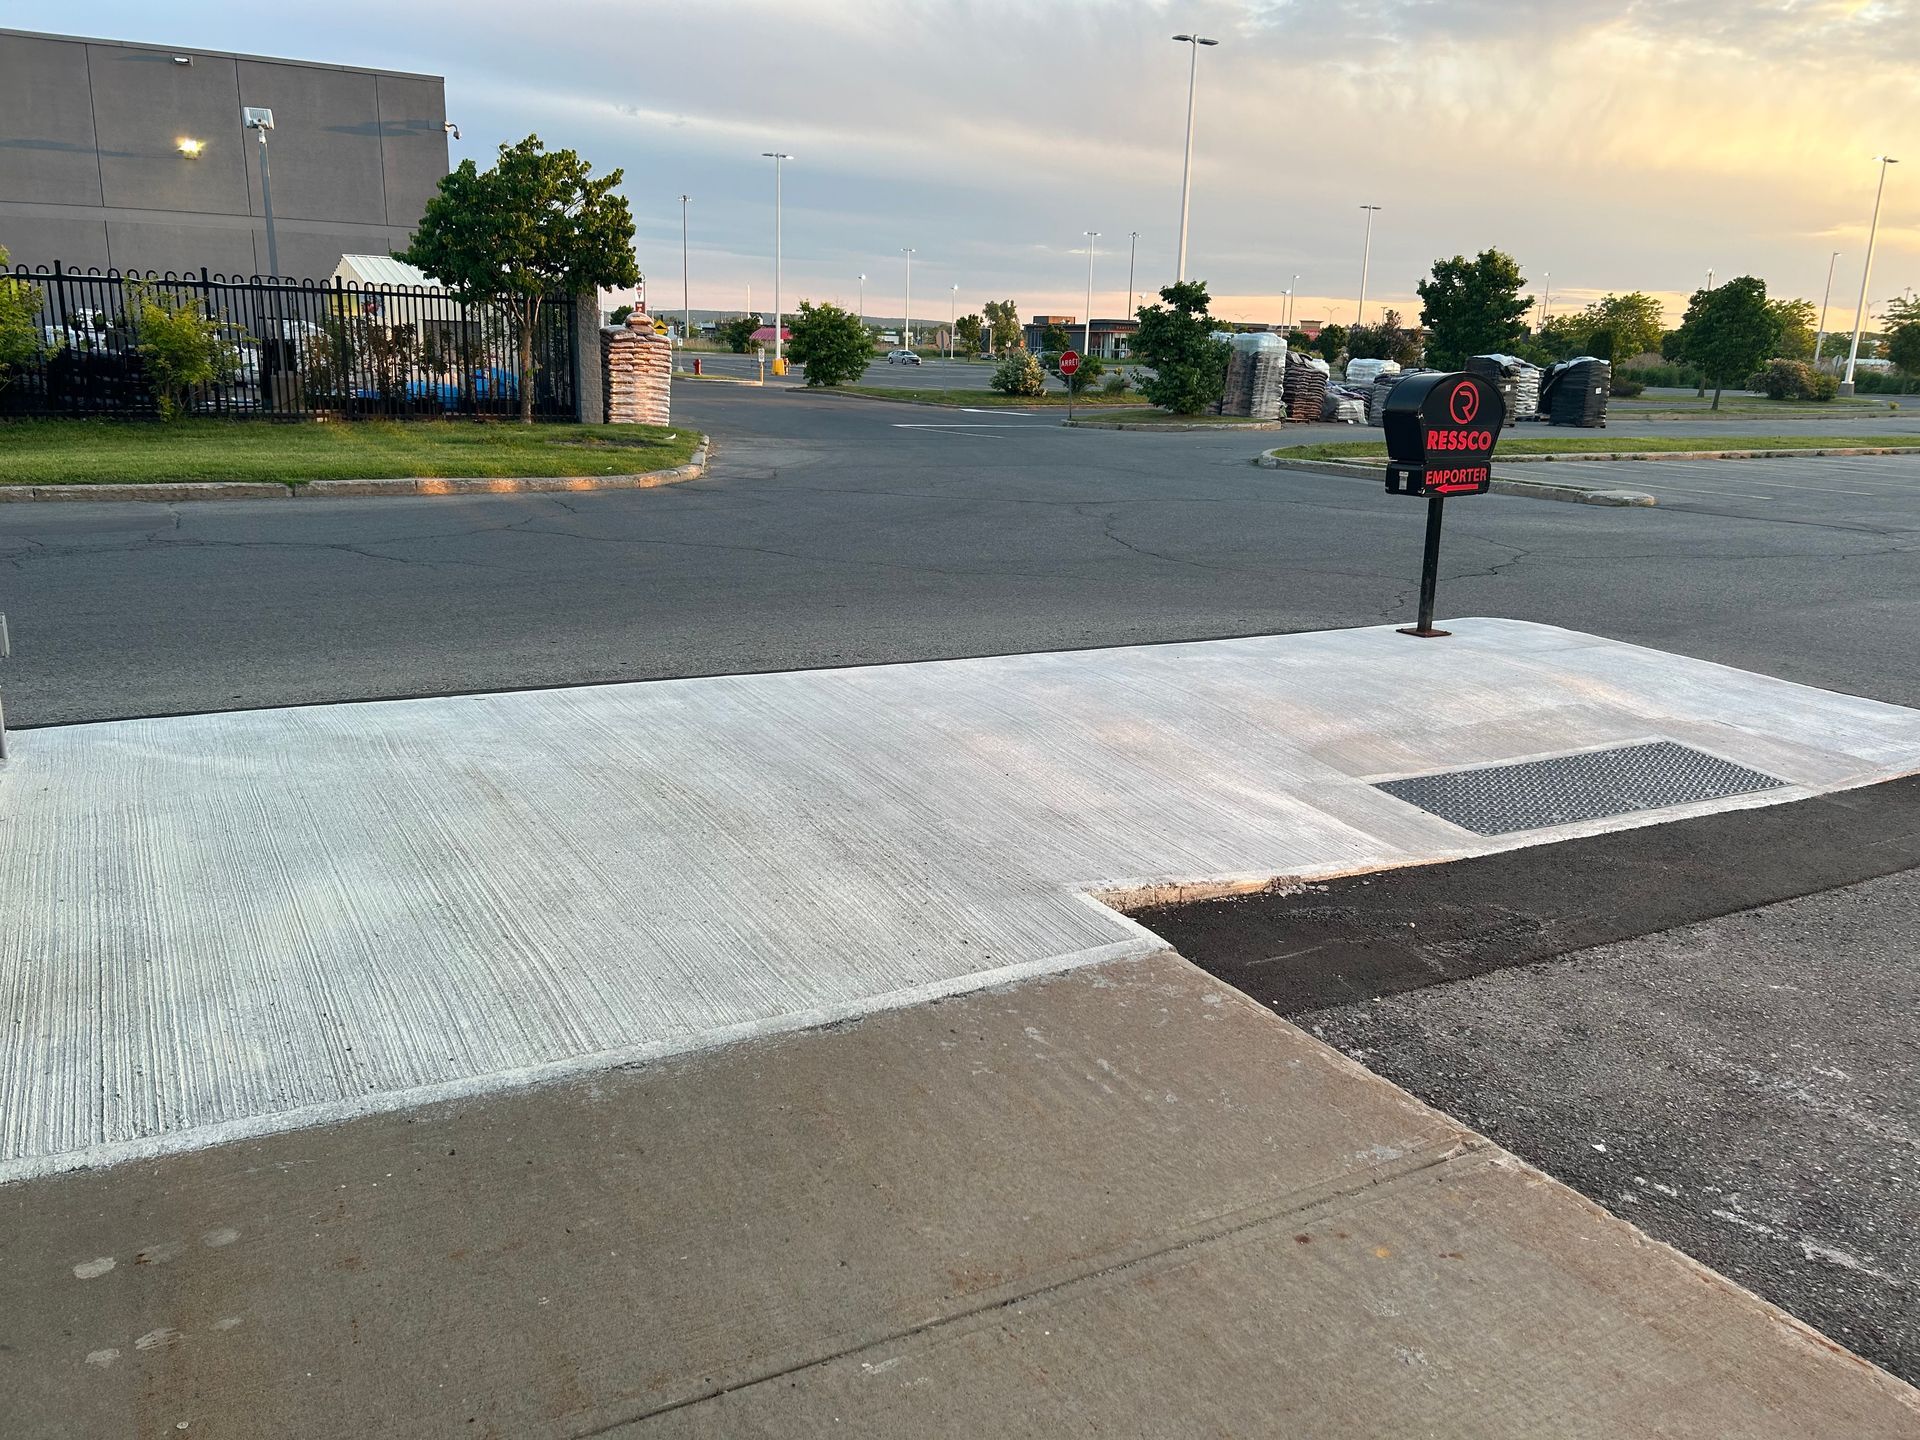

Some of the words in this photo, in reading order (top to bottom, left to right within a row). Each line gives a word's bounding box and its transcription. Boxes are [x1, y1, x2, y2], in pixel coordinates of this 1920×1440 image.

[1061, 358, 1078, 367] ARRÊT
[1427, 430, 1491, 450] RESSCO
[1426, 468, 1487, 484] EMPORTER
